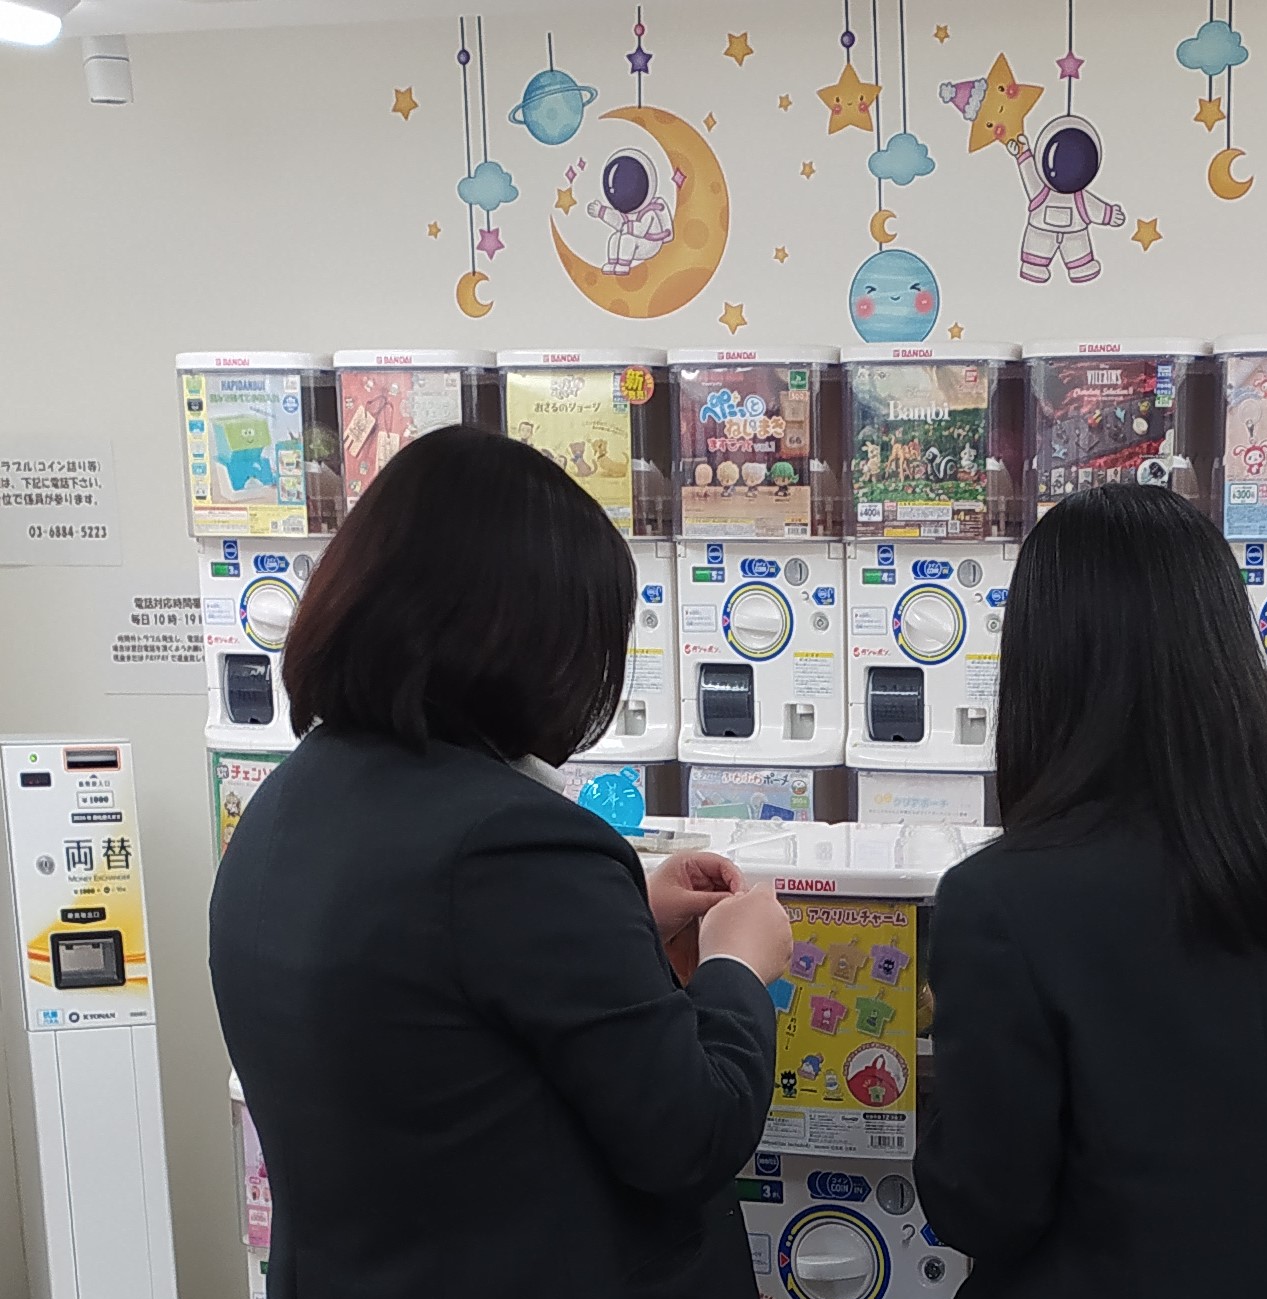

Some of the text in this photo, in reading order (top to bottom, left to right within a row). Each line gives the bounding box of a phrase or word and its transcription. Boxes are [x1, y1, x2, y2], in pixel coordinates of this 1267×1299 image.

[1088, 344, 1120, 352] BANDAI
[726, 352, 756, 360] BANDAI
[902, 350, 932, 358] BANDAI
[384, 356, 412, 364] BANDAI
[625, 368, 645, 390] 新
[887, 400, 950, 421] Bambi
[63, 838, 132, 872] 両替
[788, 880, 836, 892] BANDAI
[808, 907, 908, 927] アクリルチャーム
[831, 1183, 849, 1192] COIN
